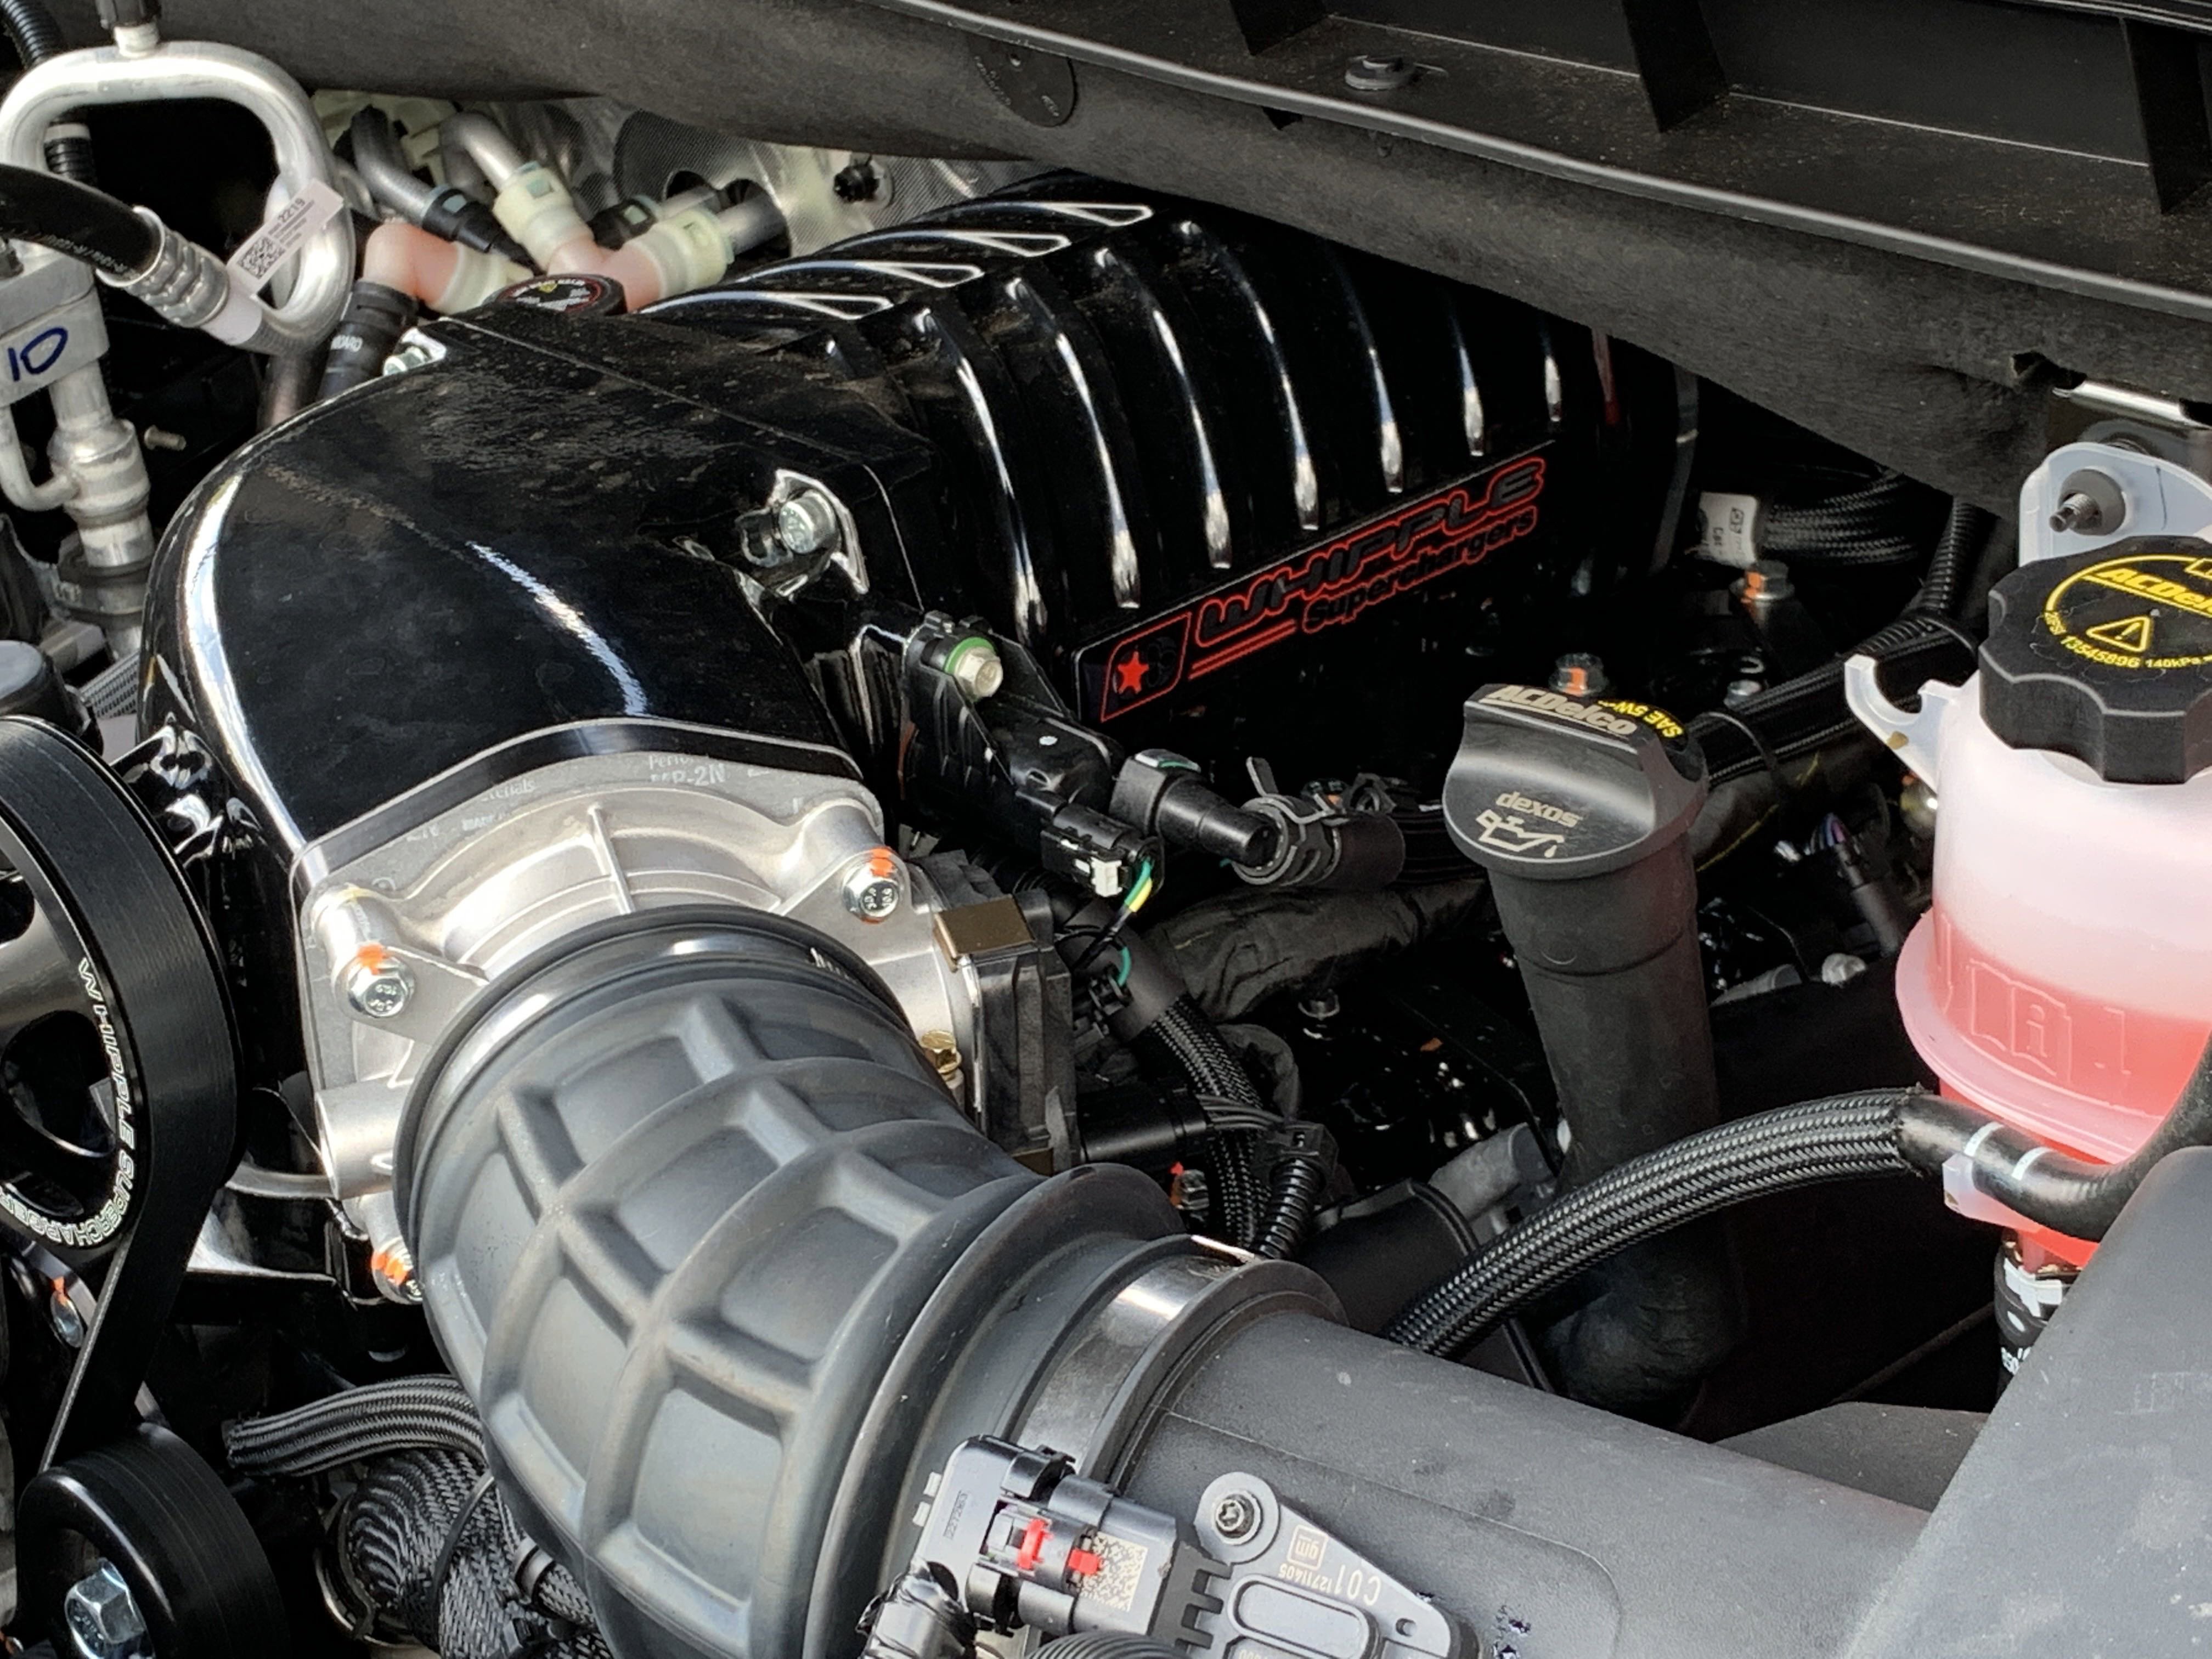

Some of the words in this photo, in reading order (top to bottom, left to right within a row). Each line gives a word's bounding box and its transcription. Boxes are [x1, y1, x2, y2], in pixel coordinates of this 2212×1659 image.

[8, 327, 68, 382] 10
[1197, 459, 1544, 646] WHIPPLE
[2092, 567, 2212, 611] ACDel
[2061, 635, 2140, 668] 13545896
[1487, 684, 1638, 735] ACDelco
[1645, 709, 1683, 738] SAE
[1496, 791, 1580, 827] dexos
[78, 957, 136, 1150] WHIPPLE
[0, 1150, 134, 1246] SUPERCHARGER
[1295, 1534, 1321, 1560] gm
